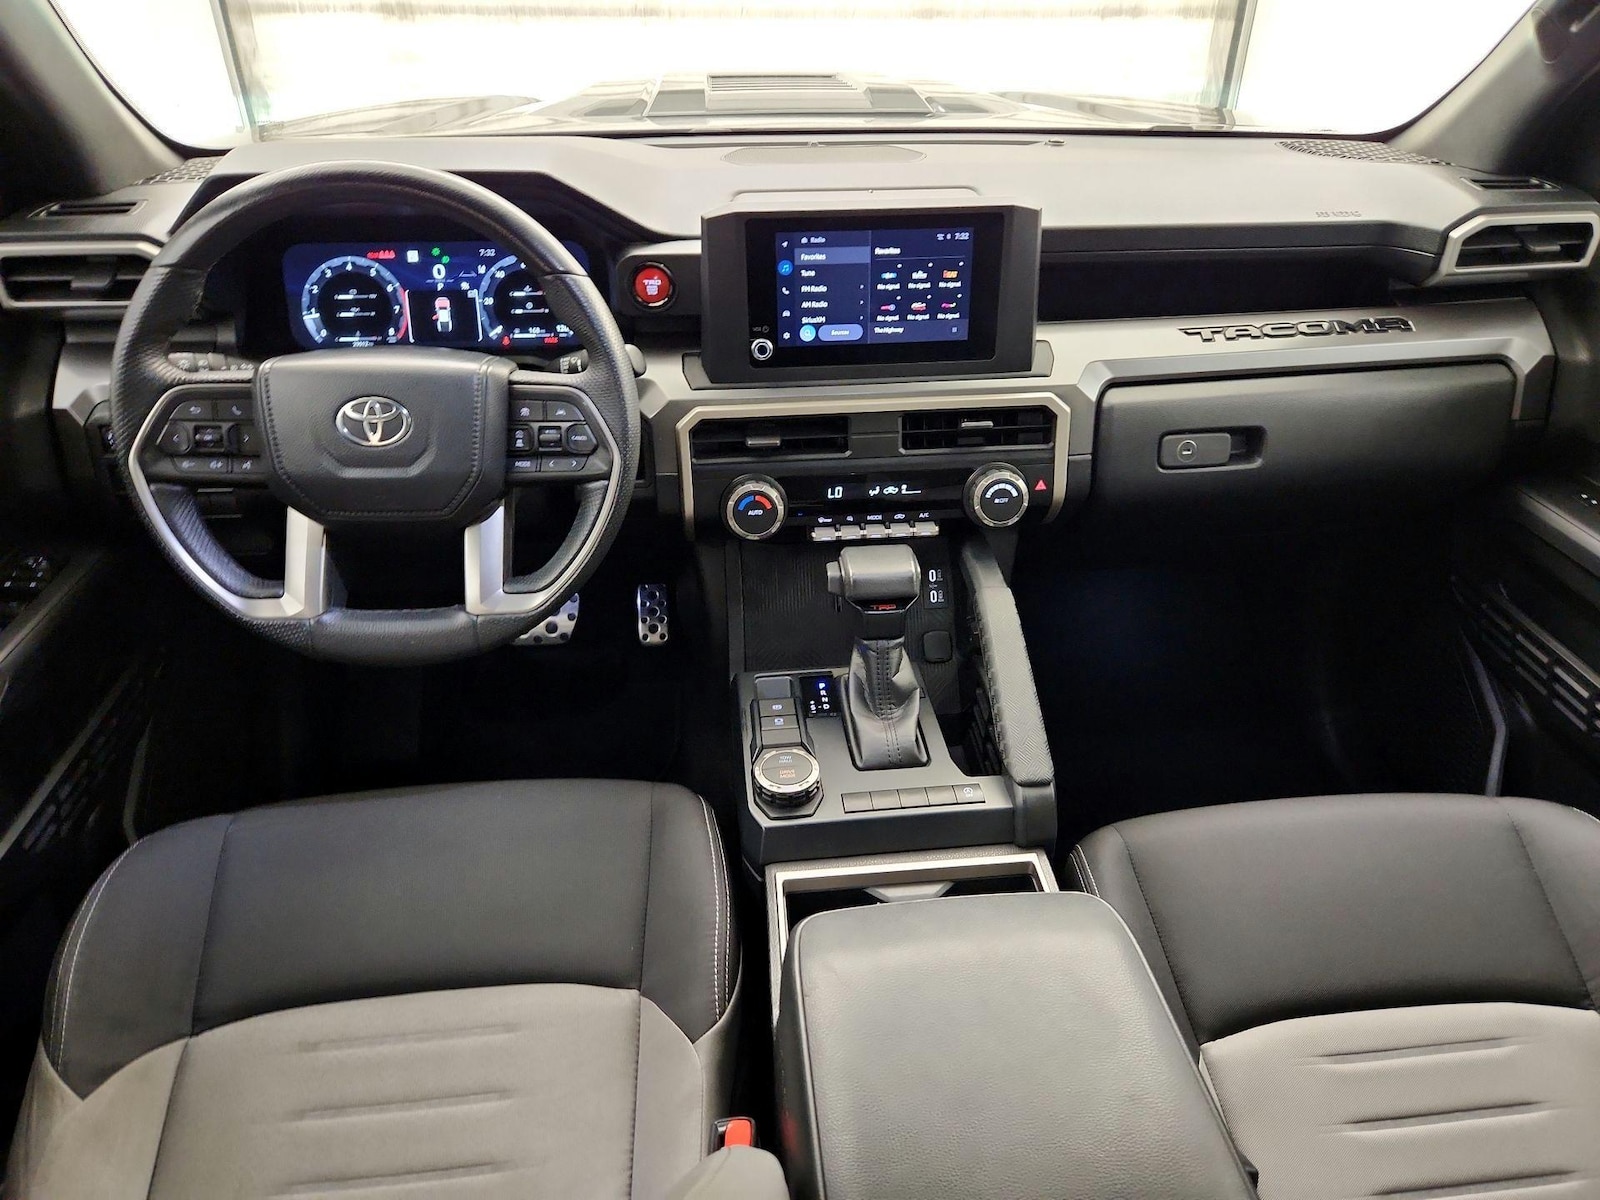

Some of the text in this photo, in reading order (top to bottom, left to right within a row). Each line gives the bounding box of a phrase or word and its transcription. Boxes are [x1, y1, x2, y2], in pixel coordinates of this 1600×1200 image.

[479, 248, 497, 257] 7:32
[874, 246, 901, 255] Favorites
[801, 253, 827, 261] Favorites
[432, 263, 446, 280] 0
[801, 269, 816, 277] Tune
[811, 285, 828, 293] Radio
[483, 297, 494, 306] 20
[812, 300, 829, 308] Radio
[802, 316, 826, 324] SiriusXM
[1178, 316, 1416, 342] TACOMA
